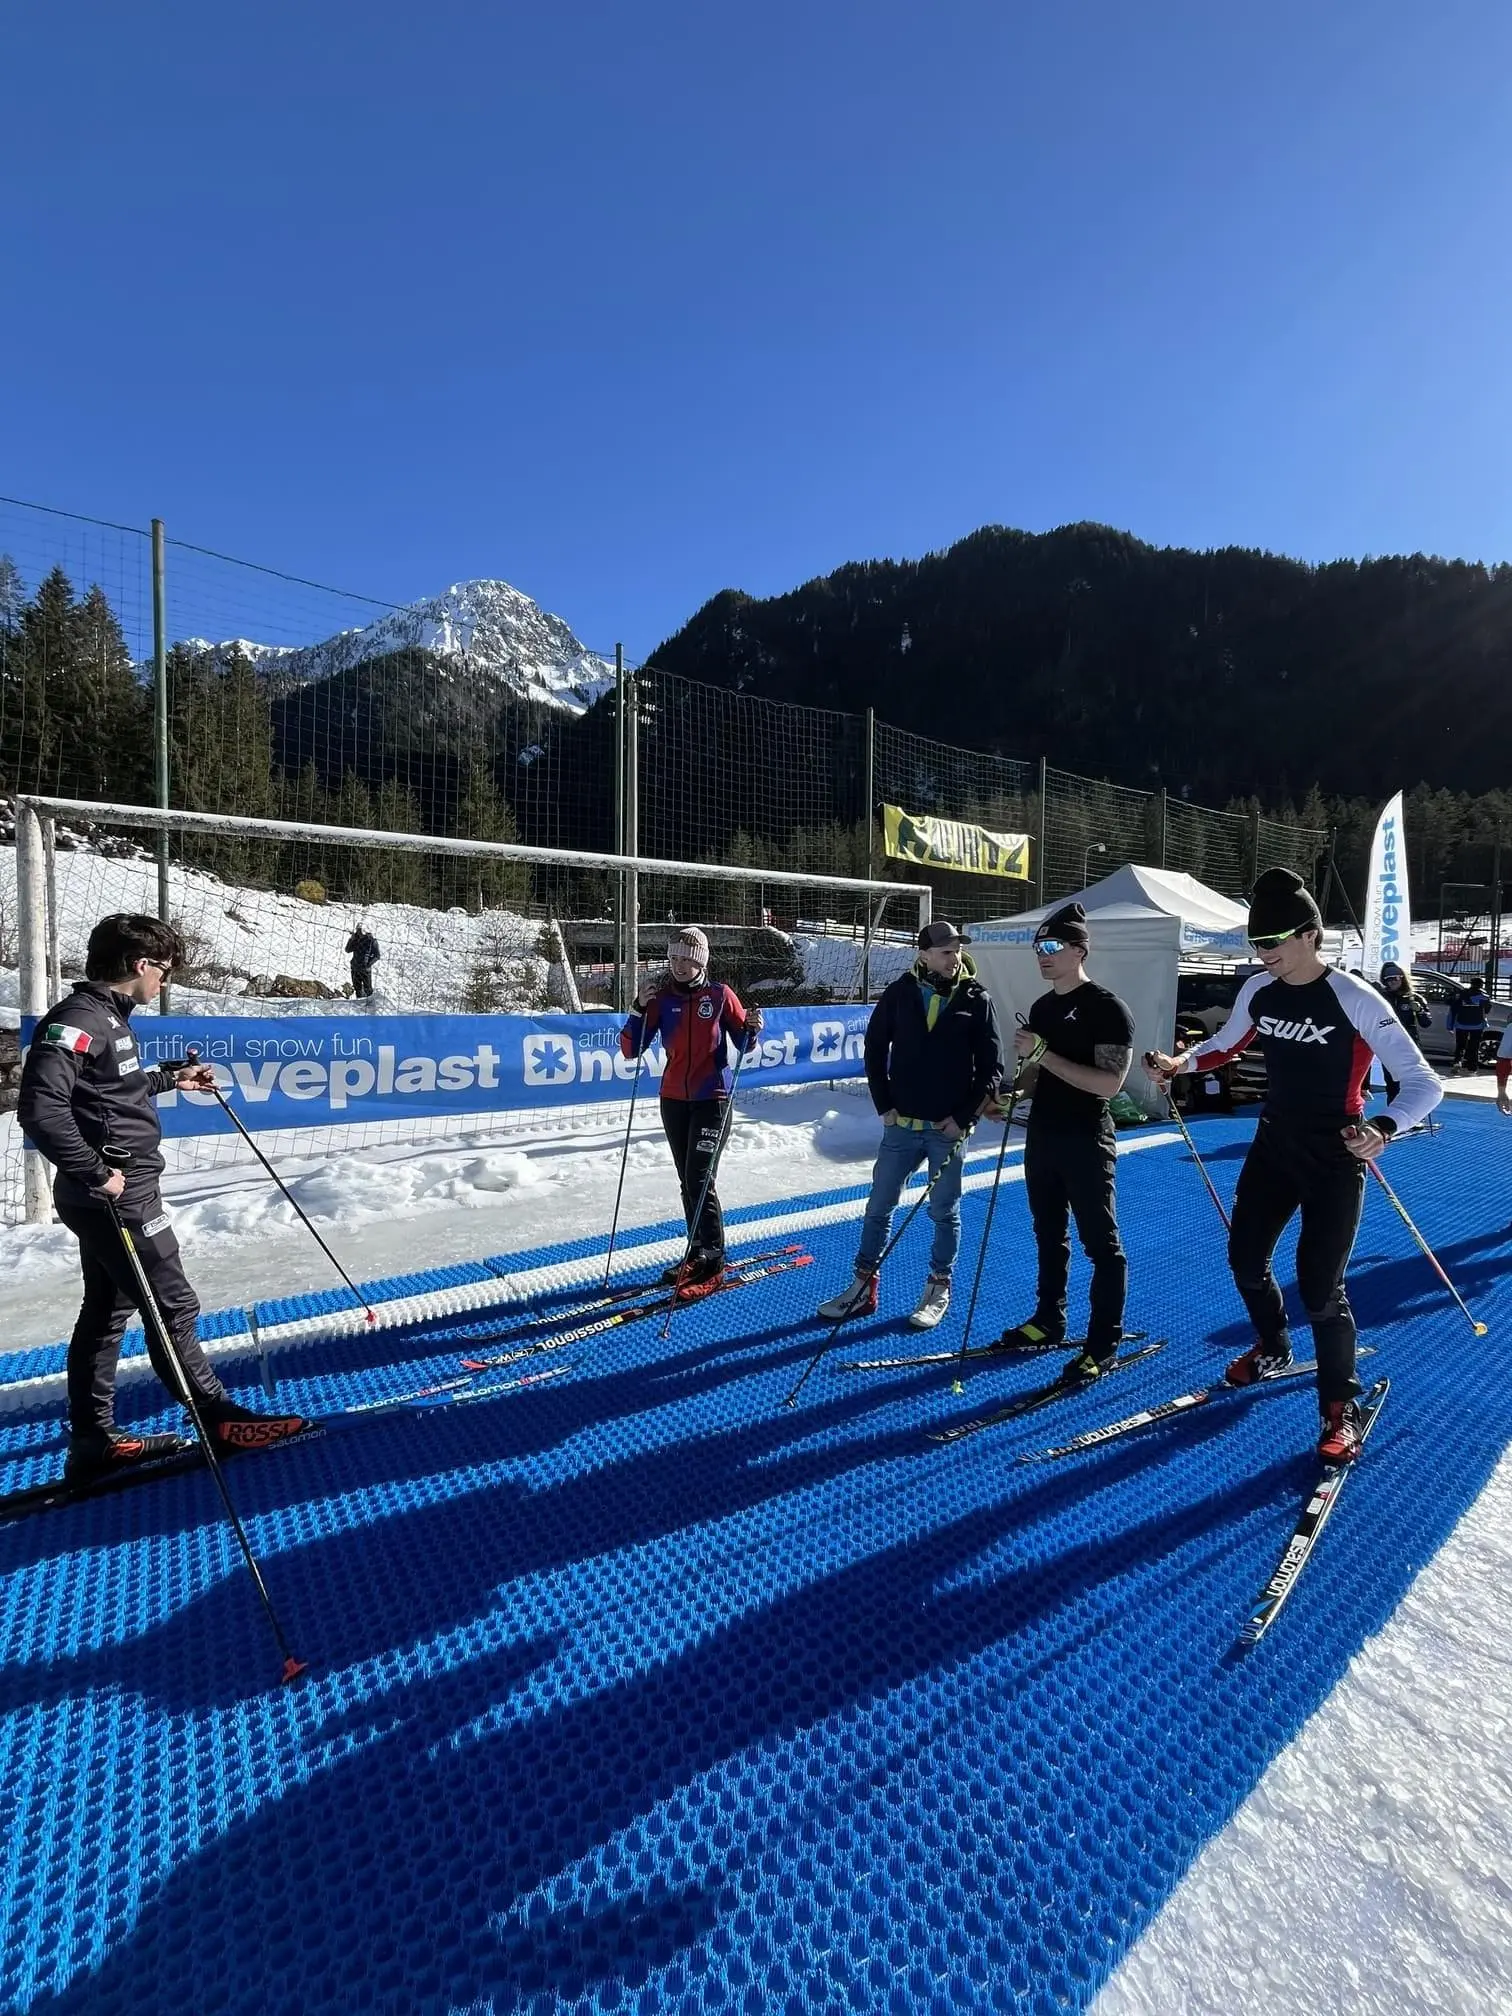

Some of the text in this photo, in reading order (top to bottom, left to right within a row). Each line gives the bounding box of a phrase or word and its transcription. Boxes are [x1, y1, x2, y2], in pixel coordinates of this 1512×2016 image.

[1379, 817, 1403, 963] eveplast
[981, 927, 1038, 944] nevepl
[1370, 938, 1379, 982] rtificial
[244, 1038, 324, 1059] snow
[331, 1032, 373, 1057] fun
[157, 1045, 501, 1109] eveplast
